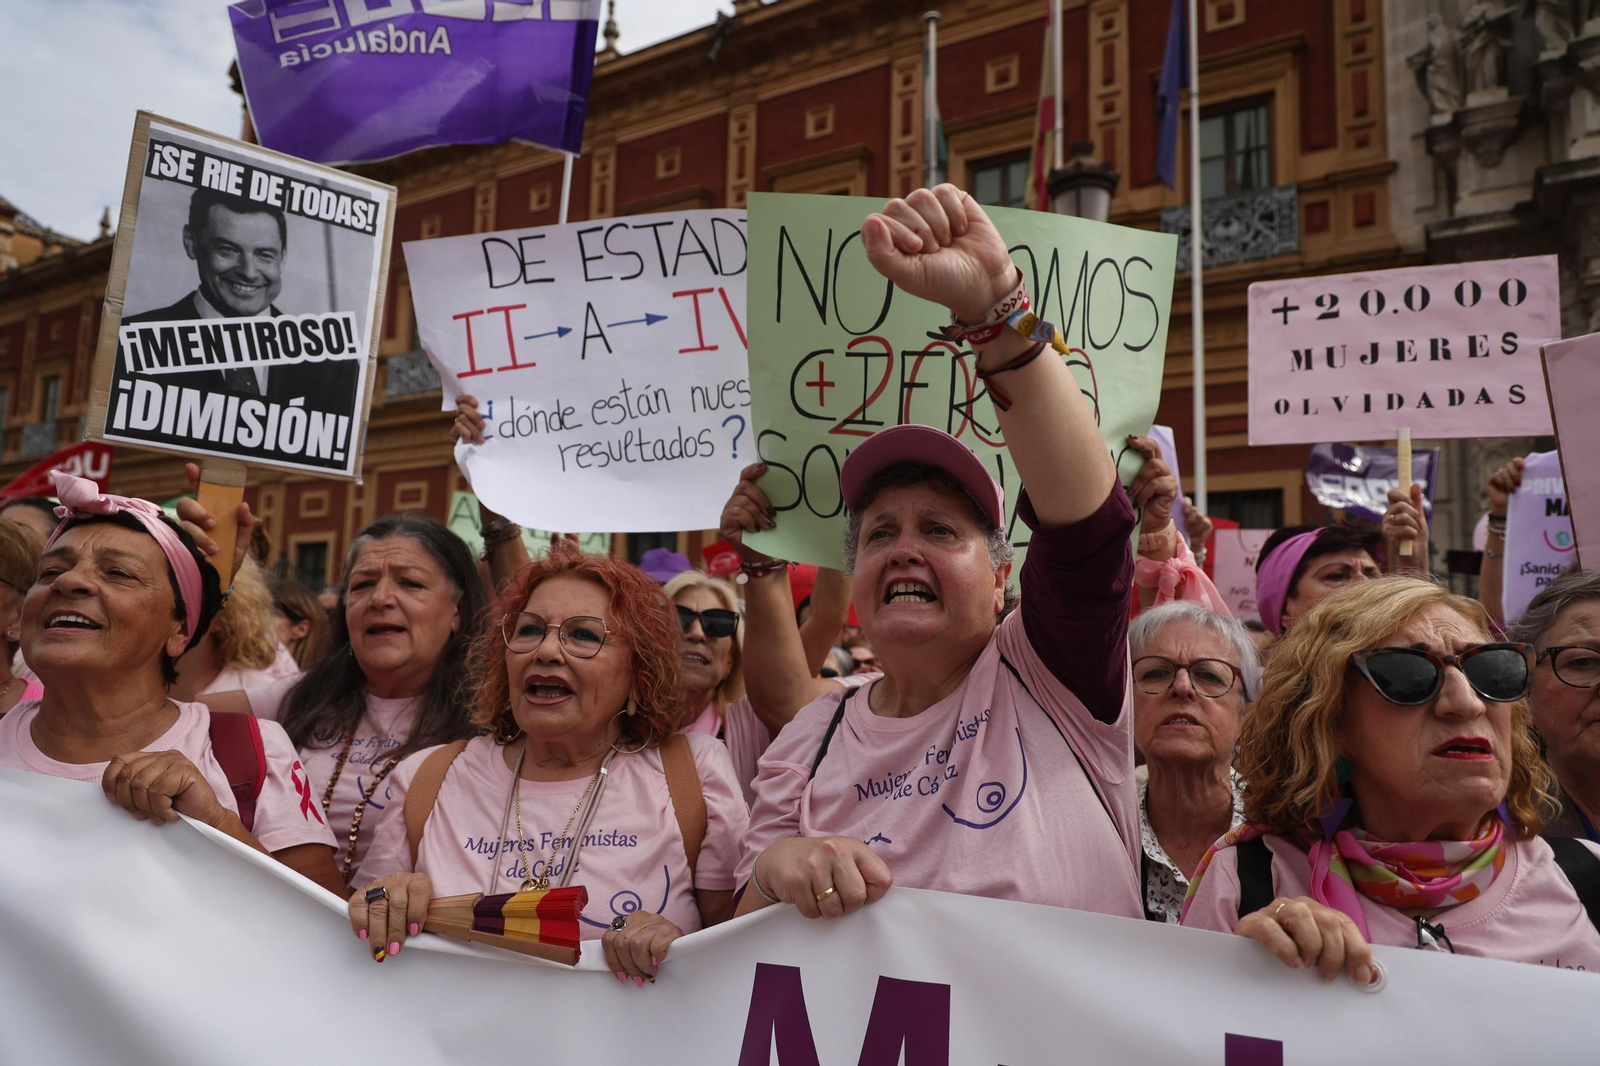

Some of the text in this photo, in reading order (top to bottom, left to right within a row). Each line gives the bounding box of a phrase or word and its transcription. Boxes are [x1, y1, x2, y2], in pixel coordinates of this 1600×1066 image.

[150, 143, 376, 232] ¡SE RIE DE TODAS!
[481, 217, 747, 289] DE ESTAD
[776, 225, 894, 335] NO
[126, 317, 356, 373] ¡MENTIROSO!
[581, 302, 612, 360] A
[1290, 331, 1519, 373] MUJERES
[112, 379, 350, 462] ¡DIMISIÓN!
[591, 377, 671, 426] están
[690, 378, 750, 414] nues
[1274, 383, 1527, 416] OLVIDADAS
[558, 427, 715, 472] resultados
[1520, 561, 1560, 576] ¡Sanid
[1535, 576, 1552, 588] pa
[464, 836, 535, 860] Mujeres
[506, 859, 529, 878] de
